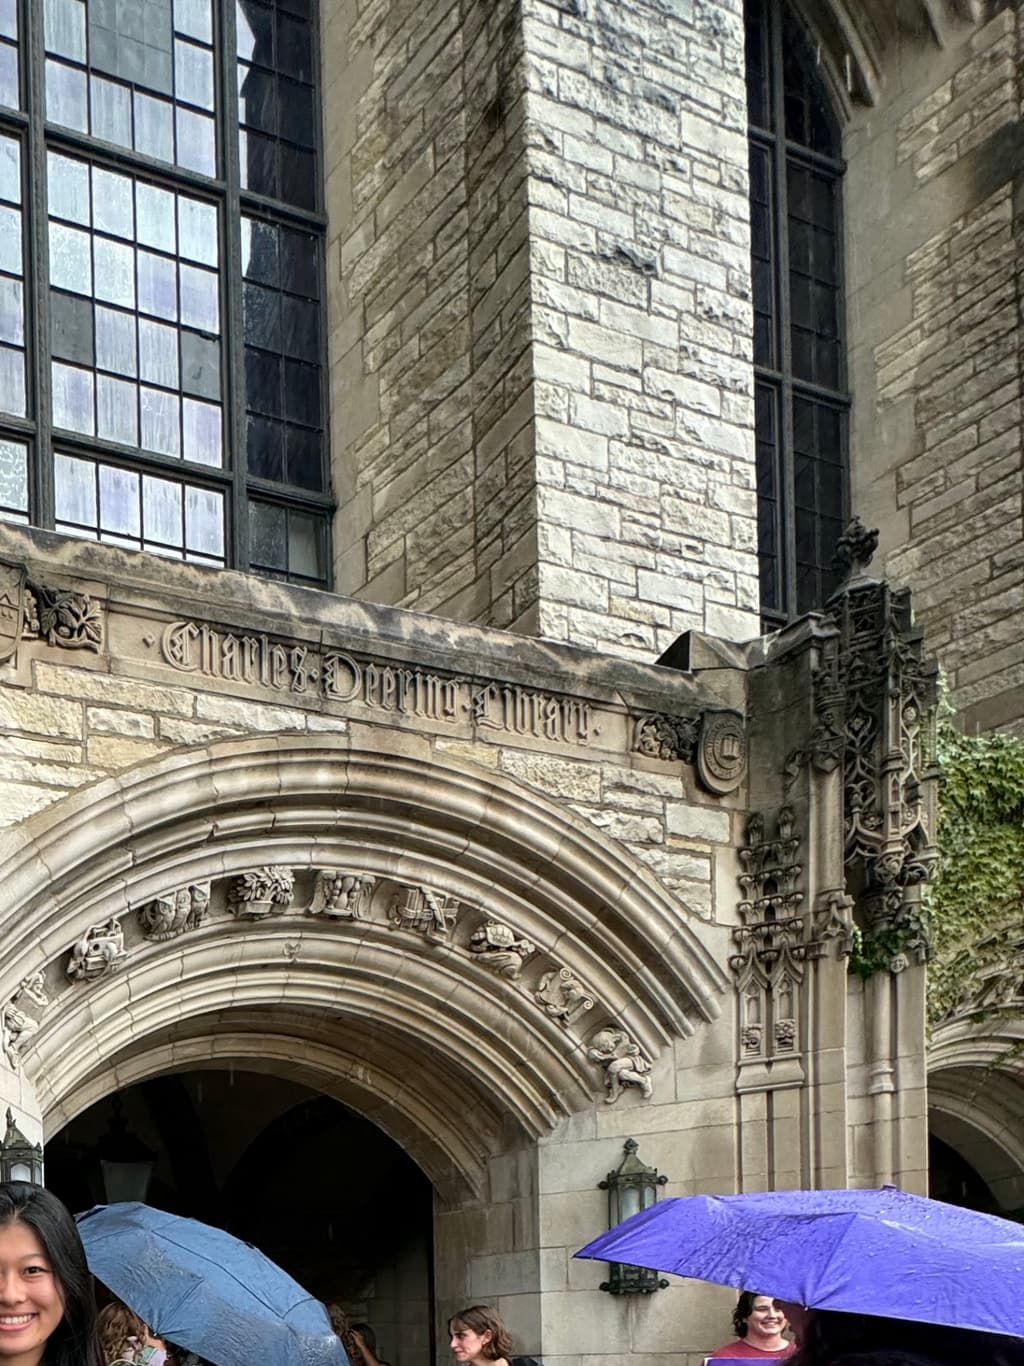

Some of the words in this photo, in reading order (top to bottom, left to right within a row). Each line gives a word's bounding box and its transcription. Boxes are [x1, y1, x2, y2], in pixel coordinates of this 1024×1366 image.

[162, 621, 308, 693] Charles
[322, 651, 466, 723] Deering
[473, 681, 592, 746] Library
